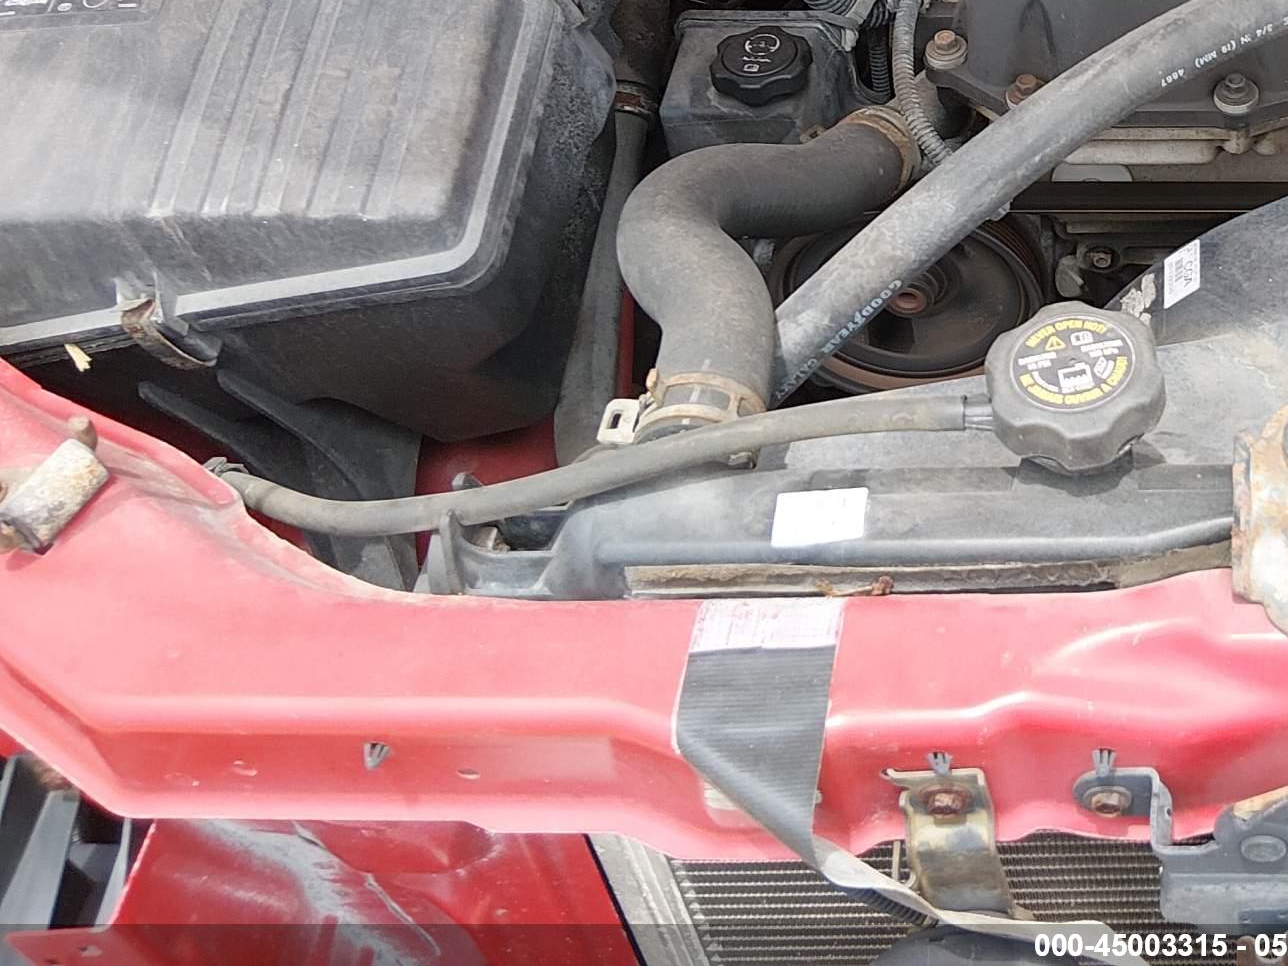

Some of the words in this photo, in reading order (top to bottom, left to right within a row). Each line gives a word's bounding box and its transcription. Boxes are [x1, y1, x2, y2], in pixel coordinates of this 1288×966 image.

[1256, 23, 1273, 37] 3/4
[1195, 50, 1217, 68] MM)
[821, 279, 902, 353] GOODYEAR
[1025, 325, 1056, 348] NEVER
[1054, 319, 1083, 331] OPEN
